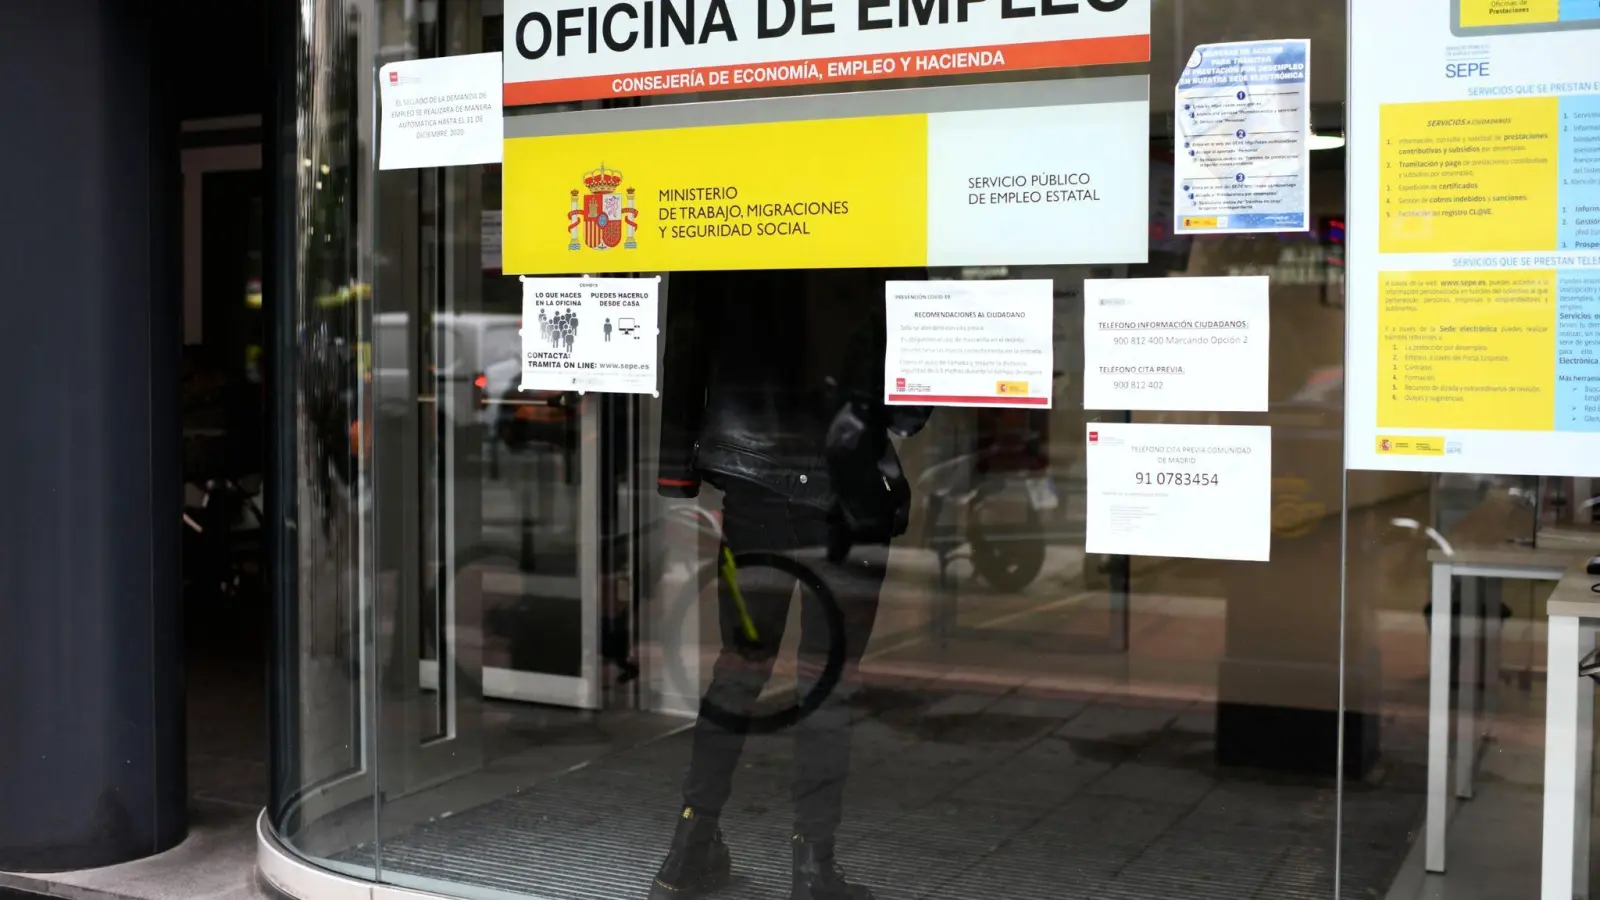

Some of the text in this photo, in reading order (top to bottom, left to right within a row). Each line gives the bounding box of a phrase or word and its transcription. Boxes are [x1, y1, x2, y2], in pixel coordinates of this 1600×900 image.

[515, 0, 738, 60] OFICINA
[757, 0, 835, 39] DE
[612, 50, 1006, 93] CONSEJERÍA DE ECONOMÍA, EMPLEO Y HACIENDA
[1445, 62, 1490, 78] SEPE
[1468, 86, 1514, 96] SERVICIOS
[1515, 84, 1536, 94] QUE
[1537, 84, 1548, 93] SE
[1550, 82, 1591, 92] PRESTAN
[476, 114, 483, 123] DE
[1426, 119, 1466, 127] SERVICIOS
[1504, 134, 1548, 142] prestaciones
[1448, 146, 1480, 154] subsidios
[1445, 160, 1462, 168] pago
[968, 172, 1091, 189] SERVICIO PÚBLICO
[658, 186, 738, 202] MINISTERIO
[968, 189, 1100, 205] DE EMPLEO ESTATAL
[659, 200, 849, 222] DE TRABAJO, MIGRACIONES
[658, 222, 810, 238] Y SEGURIDAD SOCIAL
[1452, 256, 1600, 267] SERVICIOS QUE SE PRESTAN TELE
[1098, 320, 1136, 329] TELÉFONO
[1137, 319, 1192, 329] INFORMACIÓN
[1113, 336, 1128, 345] 900
[1131, 336, 1145, 345] 812
[1148, 336, 1163, 344] 400
[1166, 336, 1209, 344] Marcando
[1099, 364, 1136, 373] TELÉFONO
[1113, 381, 1163, 389] 900 812 402
[1182, 446, 1206, 454] PREVIA
[1208, 446, 1252, 455] COMUNIDAD
[1135, 472, 1219, 486] 91 0783454
